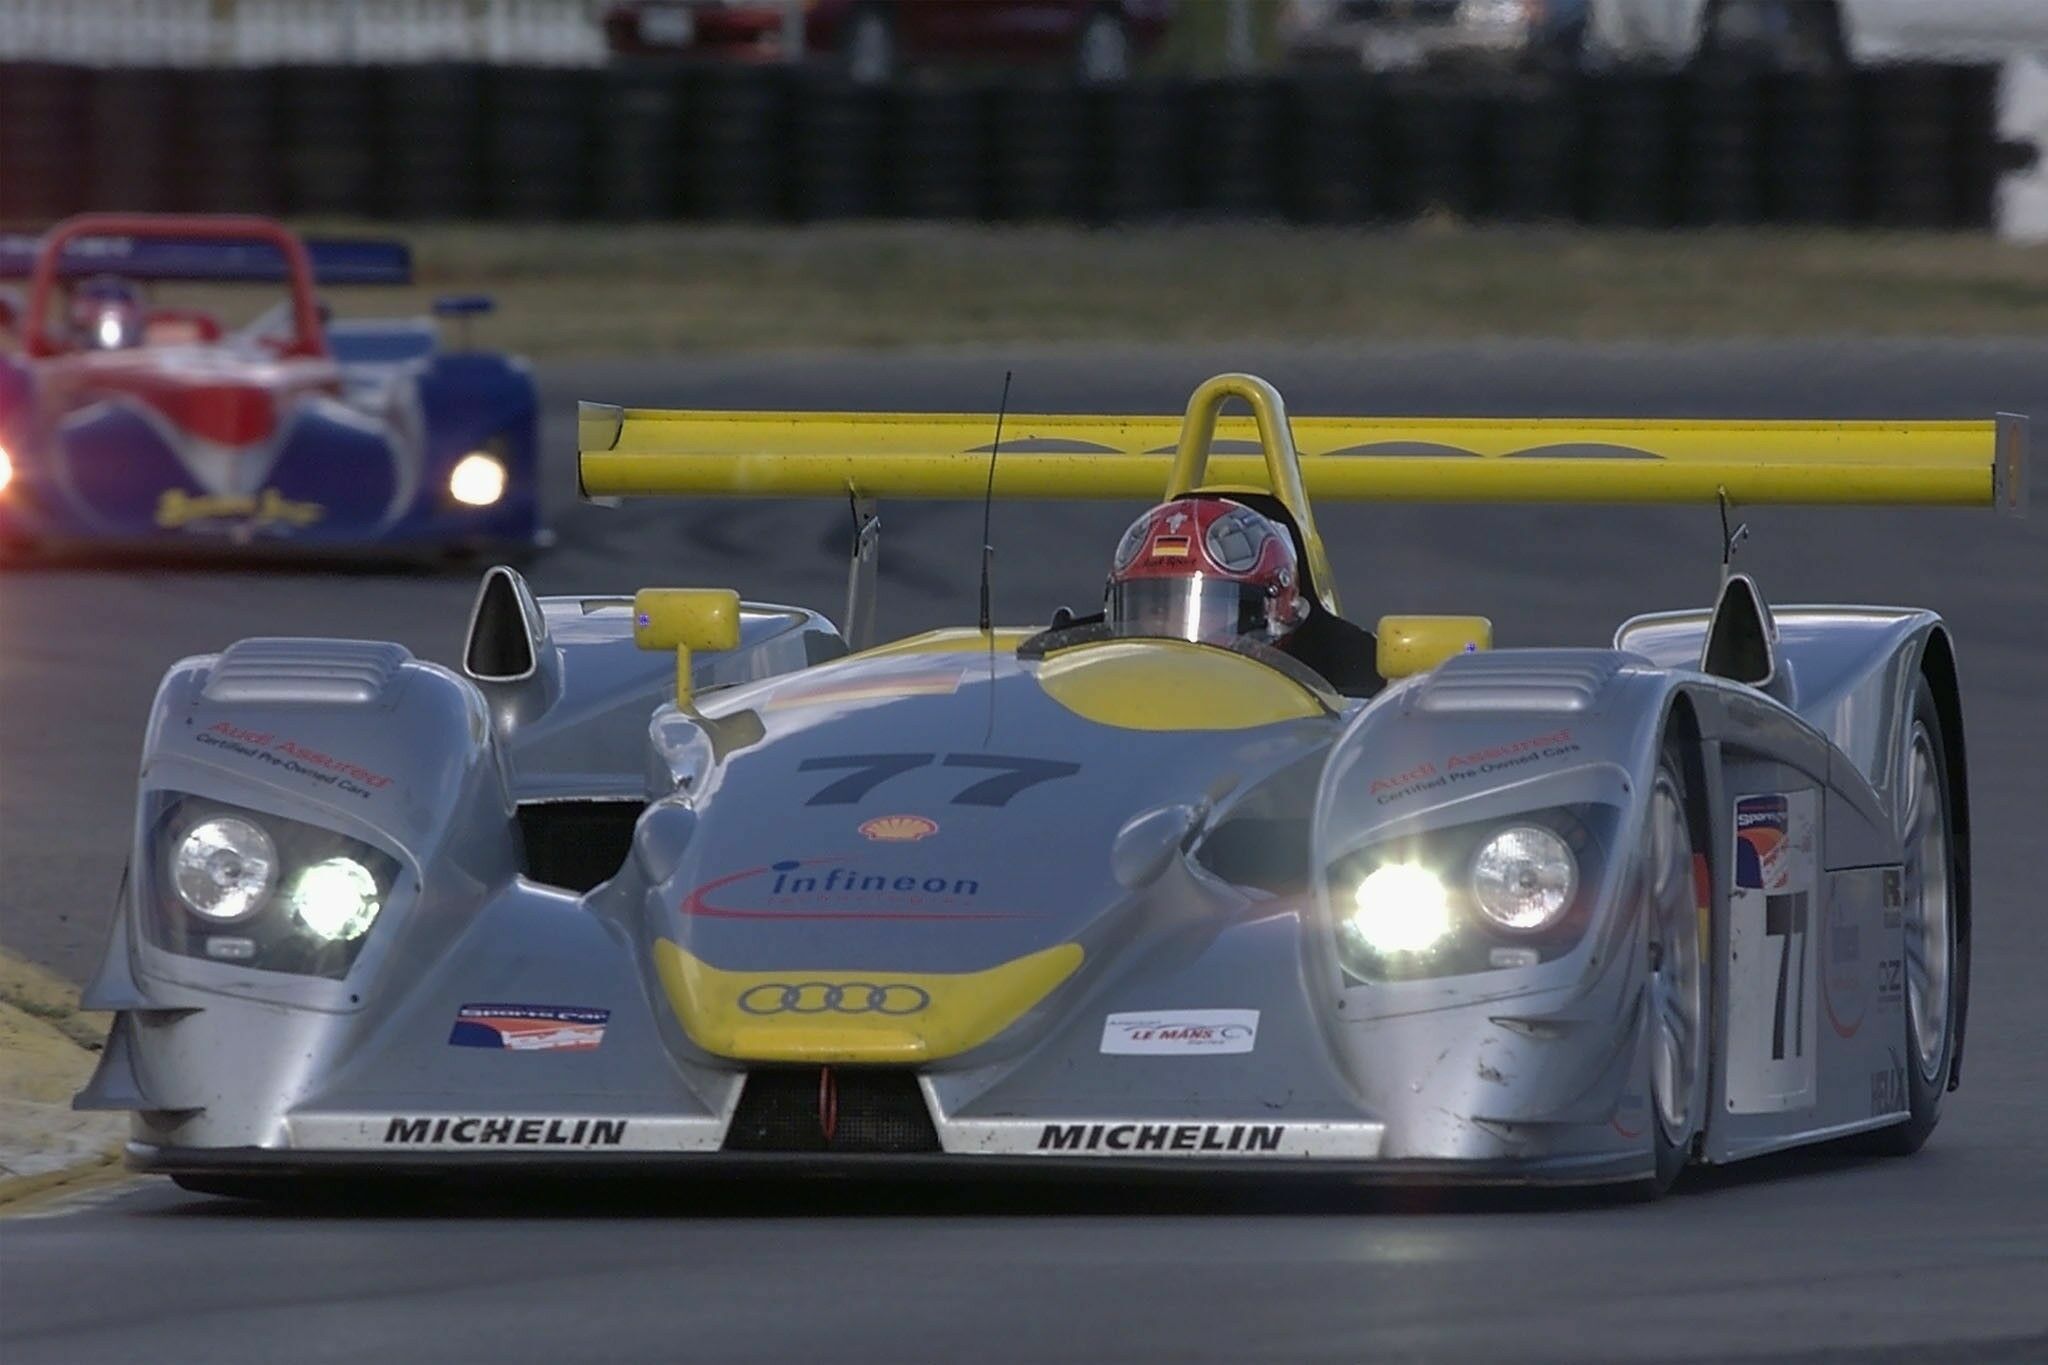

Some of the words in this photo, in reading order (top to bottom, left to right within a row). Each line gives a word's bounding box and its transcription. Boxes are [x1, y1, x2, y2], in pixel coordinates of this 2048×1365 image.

[196, 733, 257, 758] Certified
[257, 751, 338, 785] Pre-Owned
[338, 779, 371, 799] Cars
[208, 722, 274, 746] Audi
[274, 741, 394, 788] Assured
[797, 753, 1082, 807] 77
[1370, 762, 1437, 795] Audi
[1446, 729, 1571, 770] Assured
[1376, 776, 1447, 805] Certified
[1449, 752, 1540, 783] Pre-Owned
[1542, 743, 1581, 759] Cars
[1131, 1029, 1153, 1041] LE
[1158, 1029, 1214, 1041] MANS
[384, 1117, 628, 1145] MICHELIN
[1037, 1124, 1286, 1151] MICHELIN
